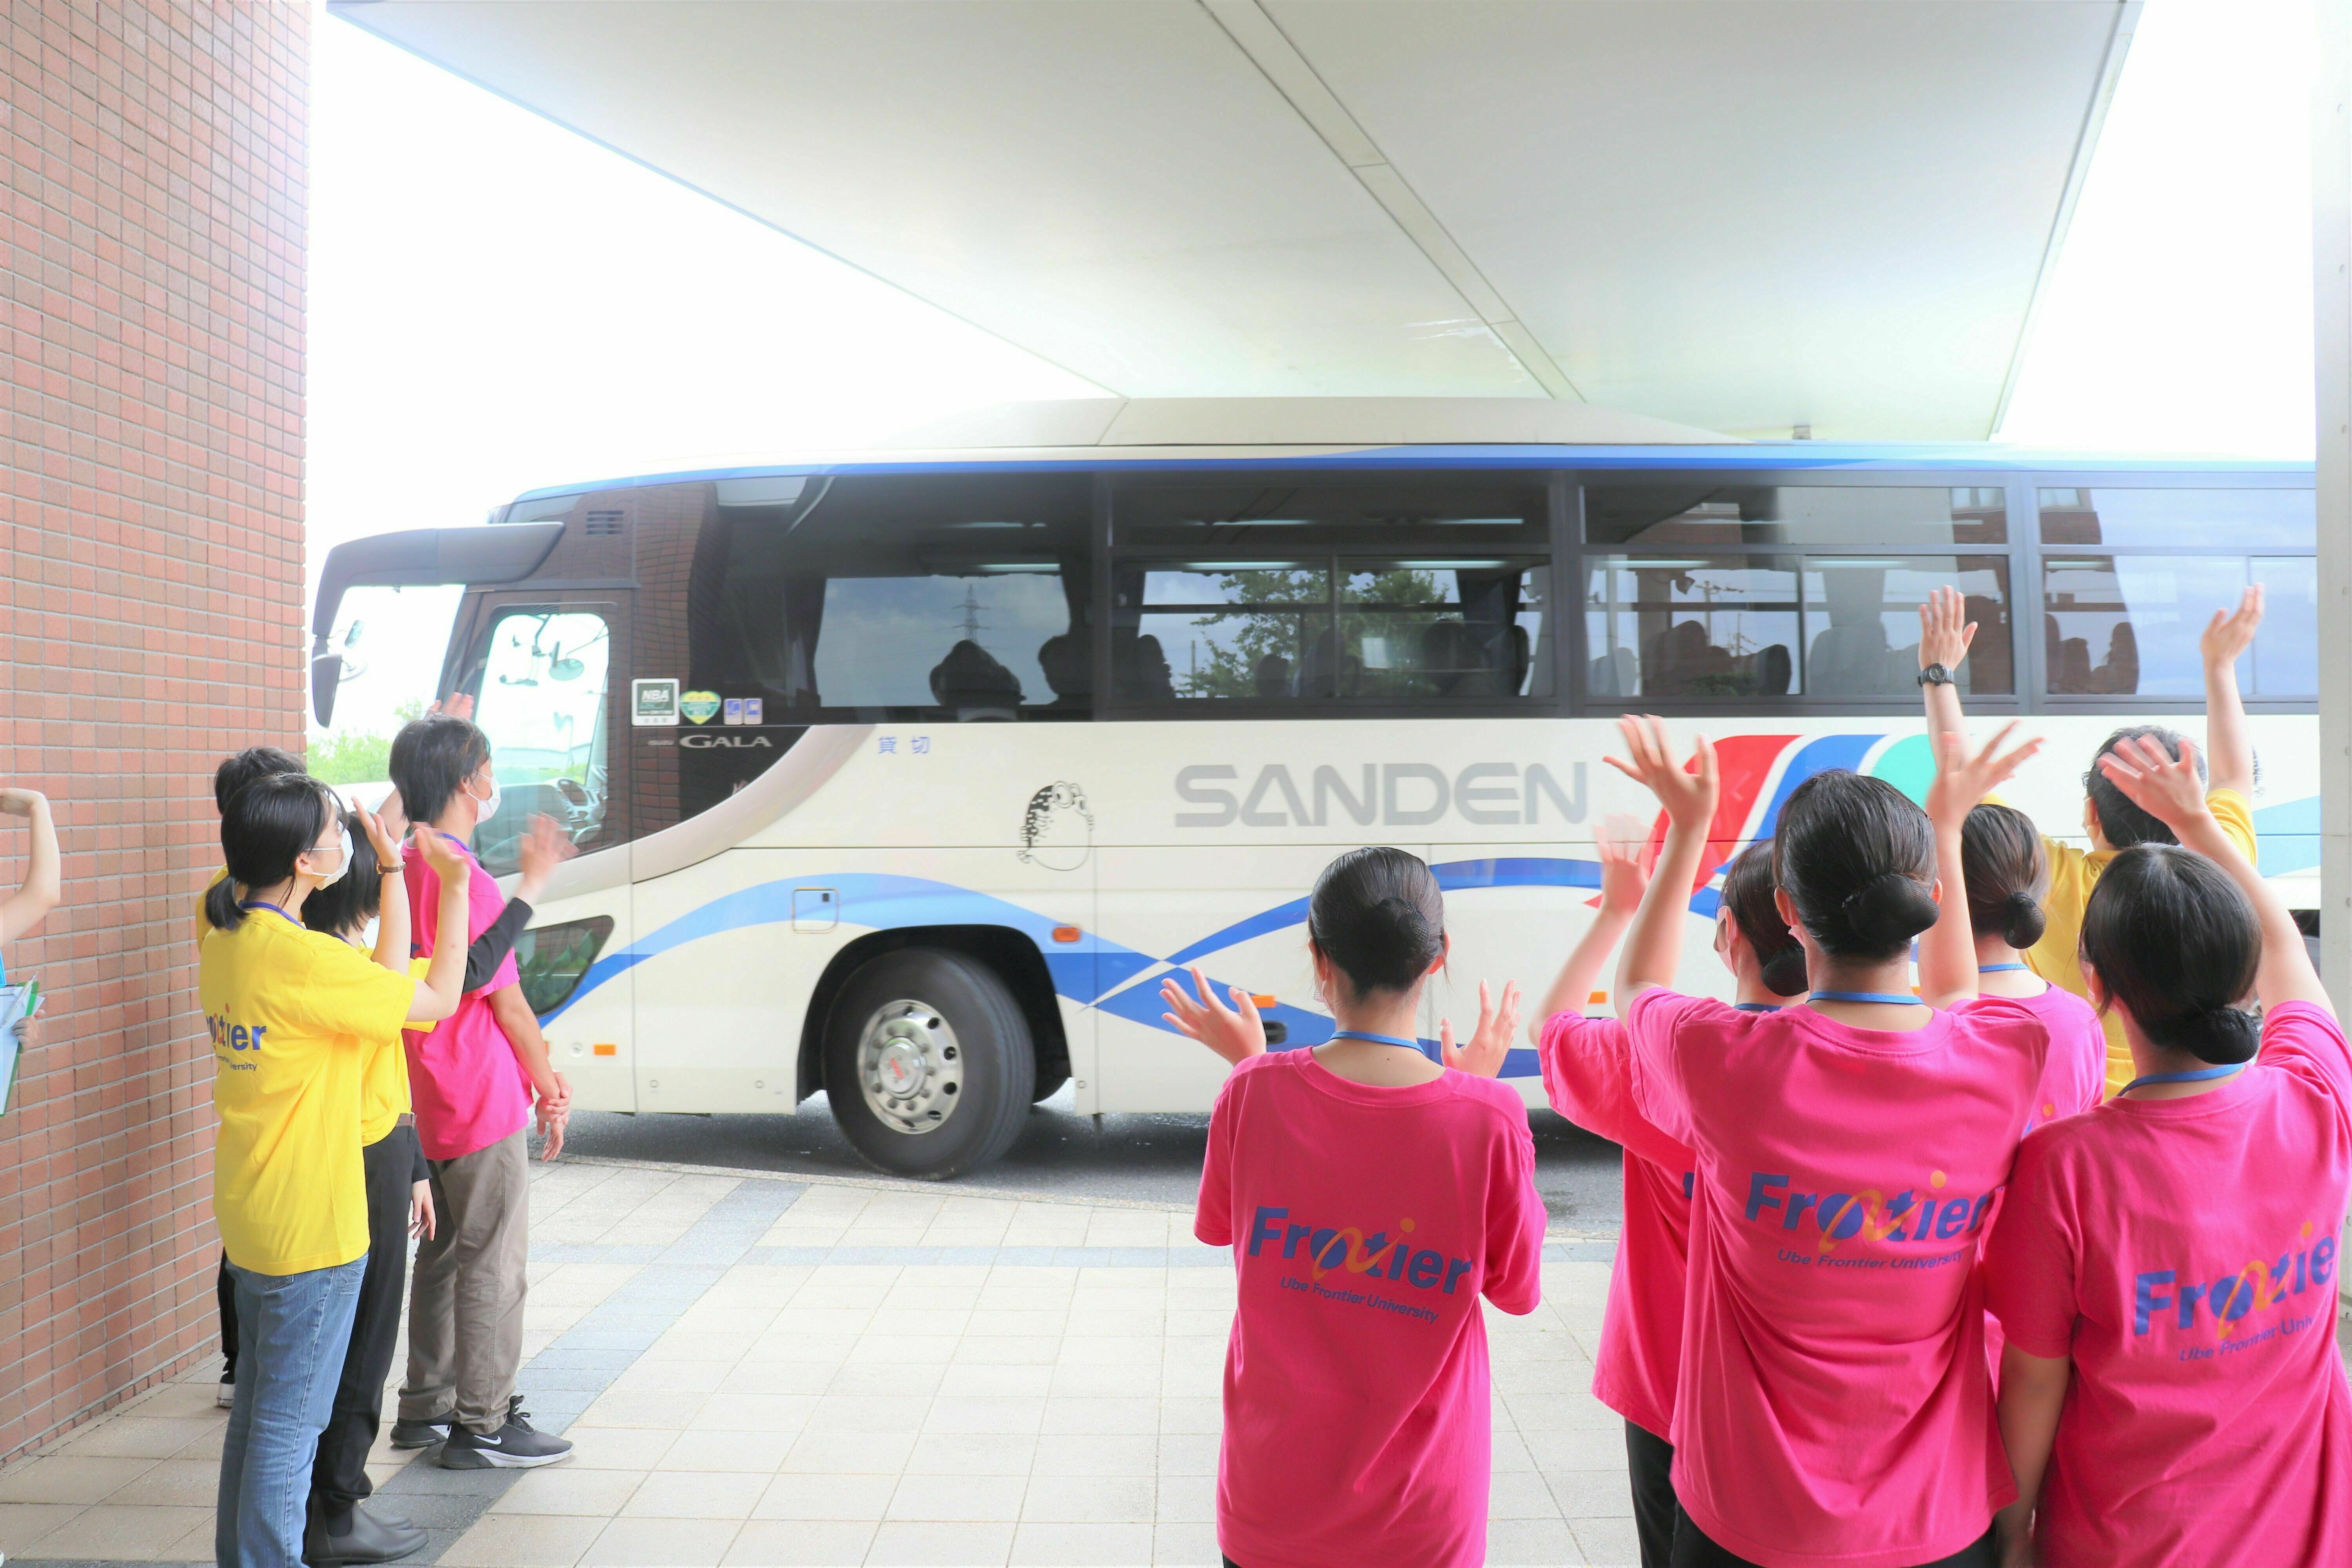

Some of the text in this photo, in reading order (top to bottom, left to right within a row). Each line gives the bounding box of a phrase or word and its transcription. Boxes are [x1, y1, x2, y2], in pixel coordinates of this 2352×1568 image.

[641, 690, 670, 701] NBA
[679, 735, 773, 748] GALA
[878, 736, 930, 754] 貸切
[1176, 761, 1588, 828] SANDEN
[1248, 1206, 1472, 1294] Frontier
[1777, 1249, 1811, 1265] Ube
[1817, 1254, 1887, 1268] Frontier
[2134, 1220, 2336, 1339] Frontie
[1280, 1276, 1440, 1325] Ube Frontier University
[2179, 1325, 2278, 1361] Ube Frontier
